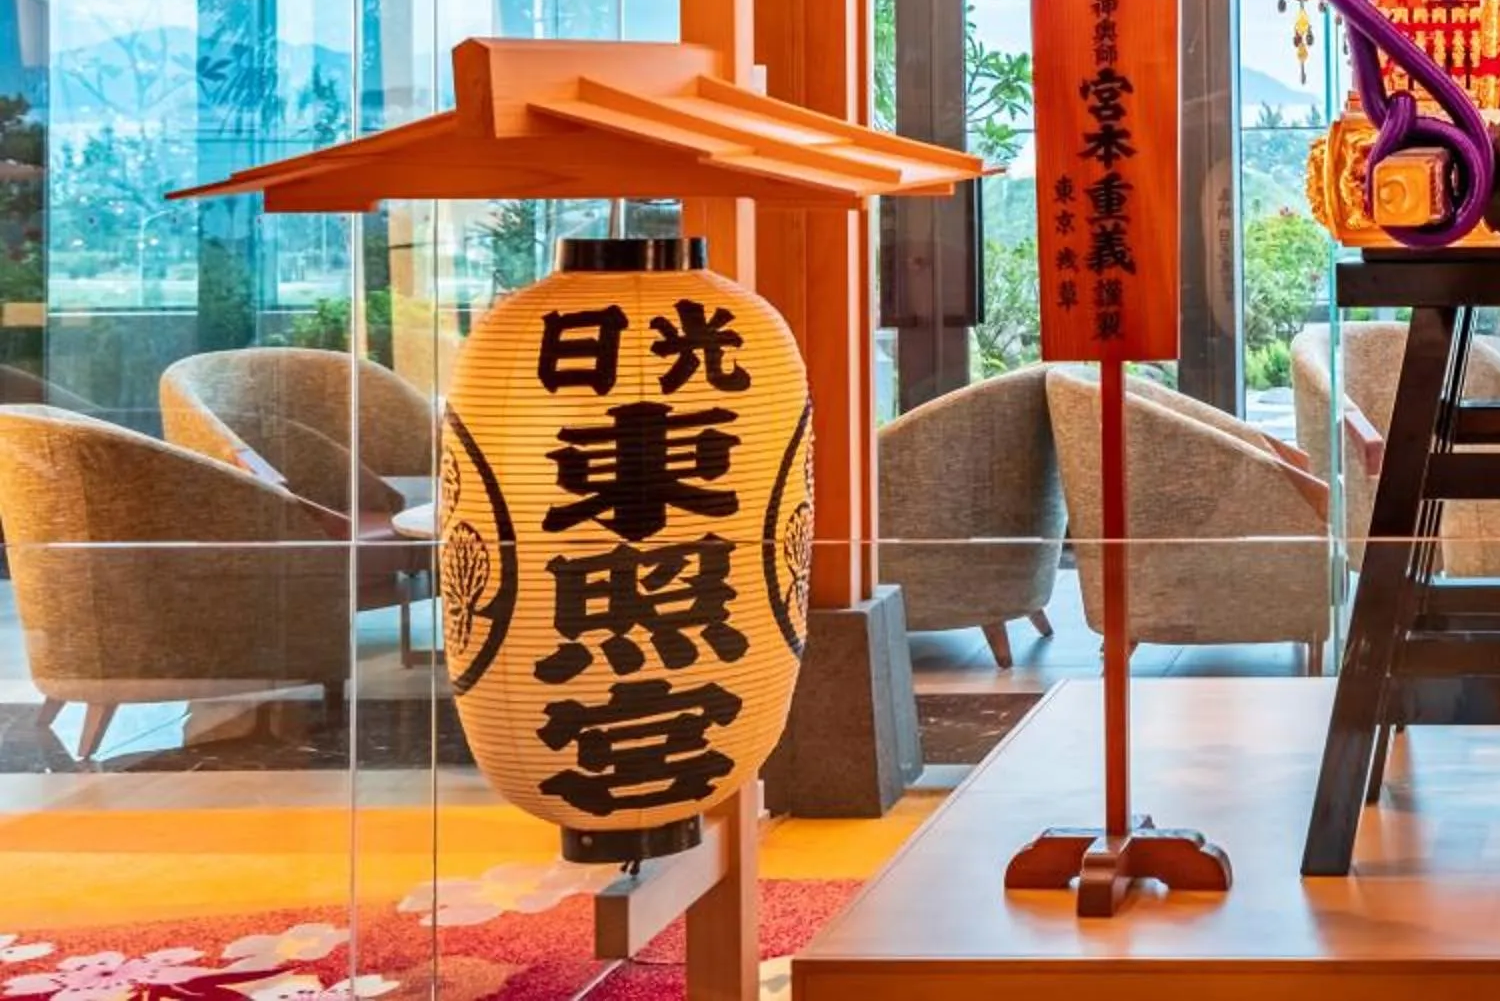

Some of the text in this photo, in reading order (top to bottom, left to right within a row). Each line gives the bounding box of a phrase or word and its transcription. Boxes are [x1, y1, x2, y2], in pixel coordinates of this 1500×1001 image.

[537, 299, 752, 396] 日光
[533, 400, 751, 816] 東照宮
